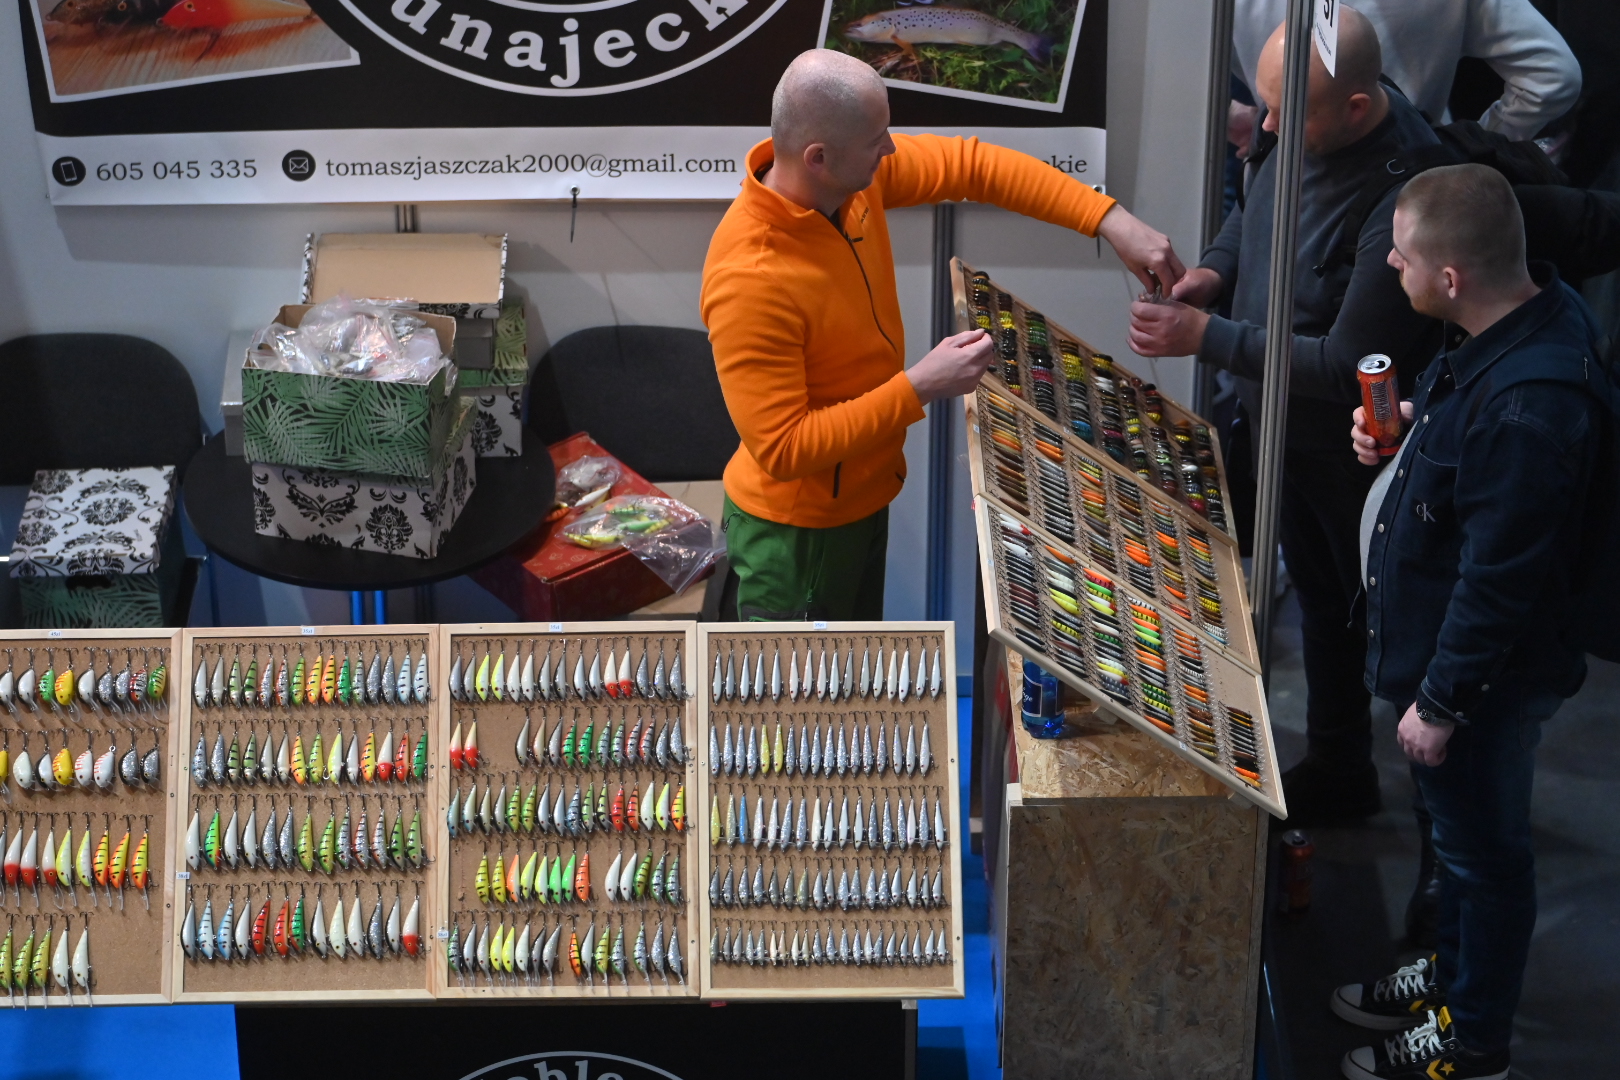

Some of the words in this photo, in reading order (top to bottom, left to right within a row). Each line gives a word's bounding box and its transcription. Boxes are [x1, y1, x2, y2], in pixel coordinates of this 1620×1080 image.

[96, 162, 144, 181] 605
[153, 160, 201, 180] 045
[210, 159, 258, 179] 335
[325, 153, 738, 181] tomaszjaszczak2000@gmail.com
[1041, 154, 1088, 174] kie
